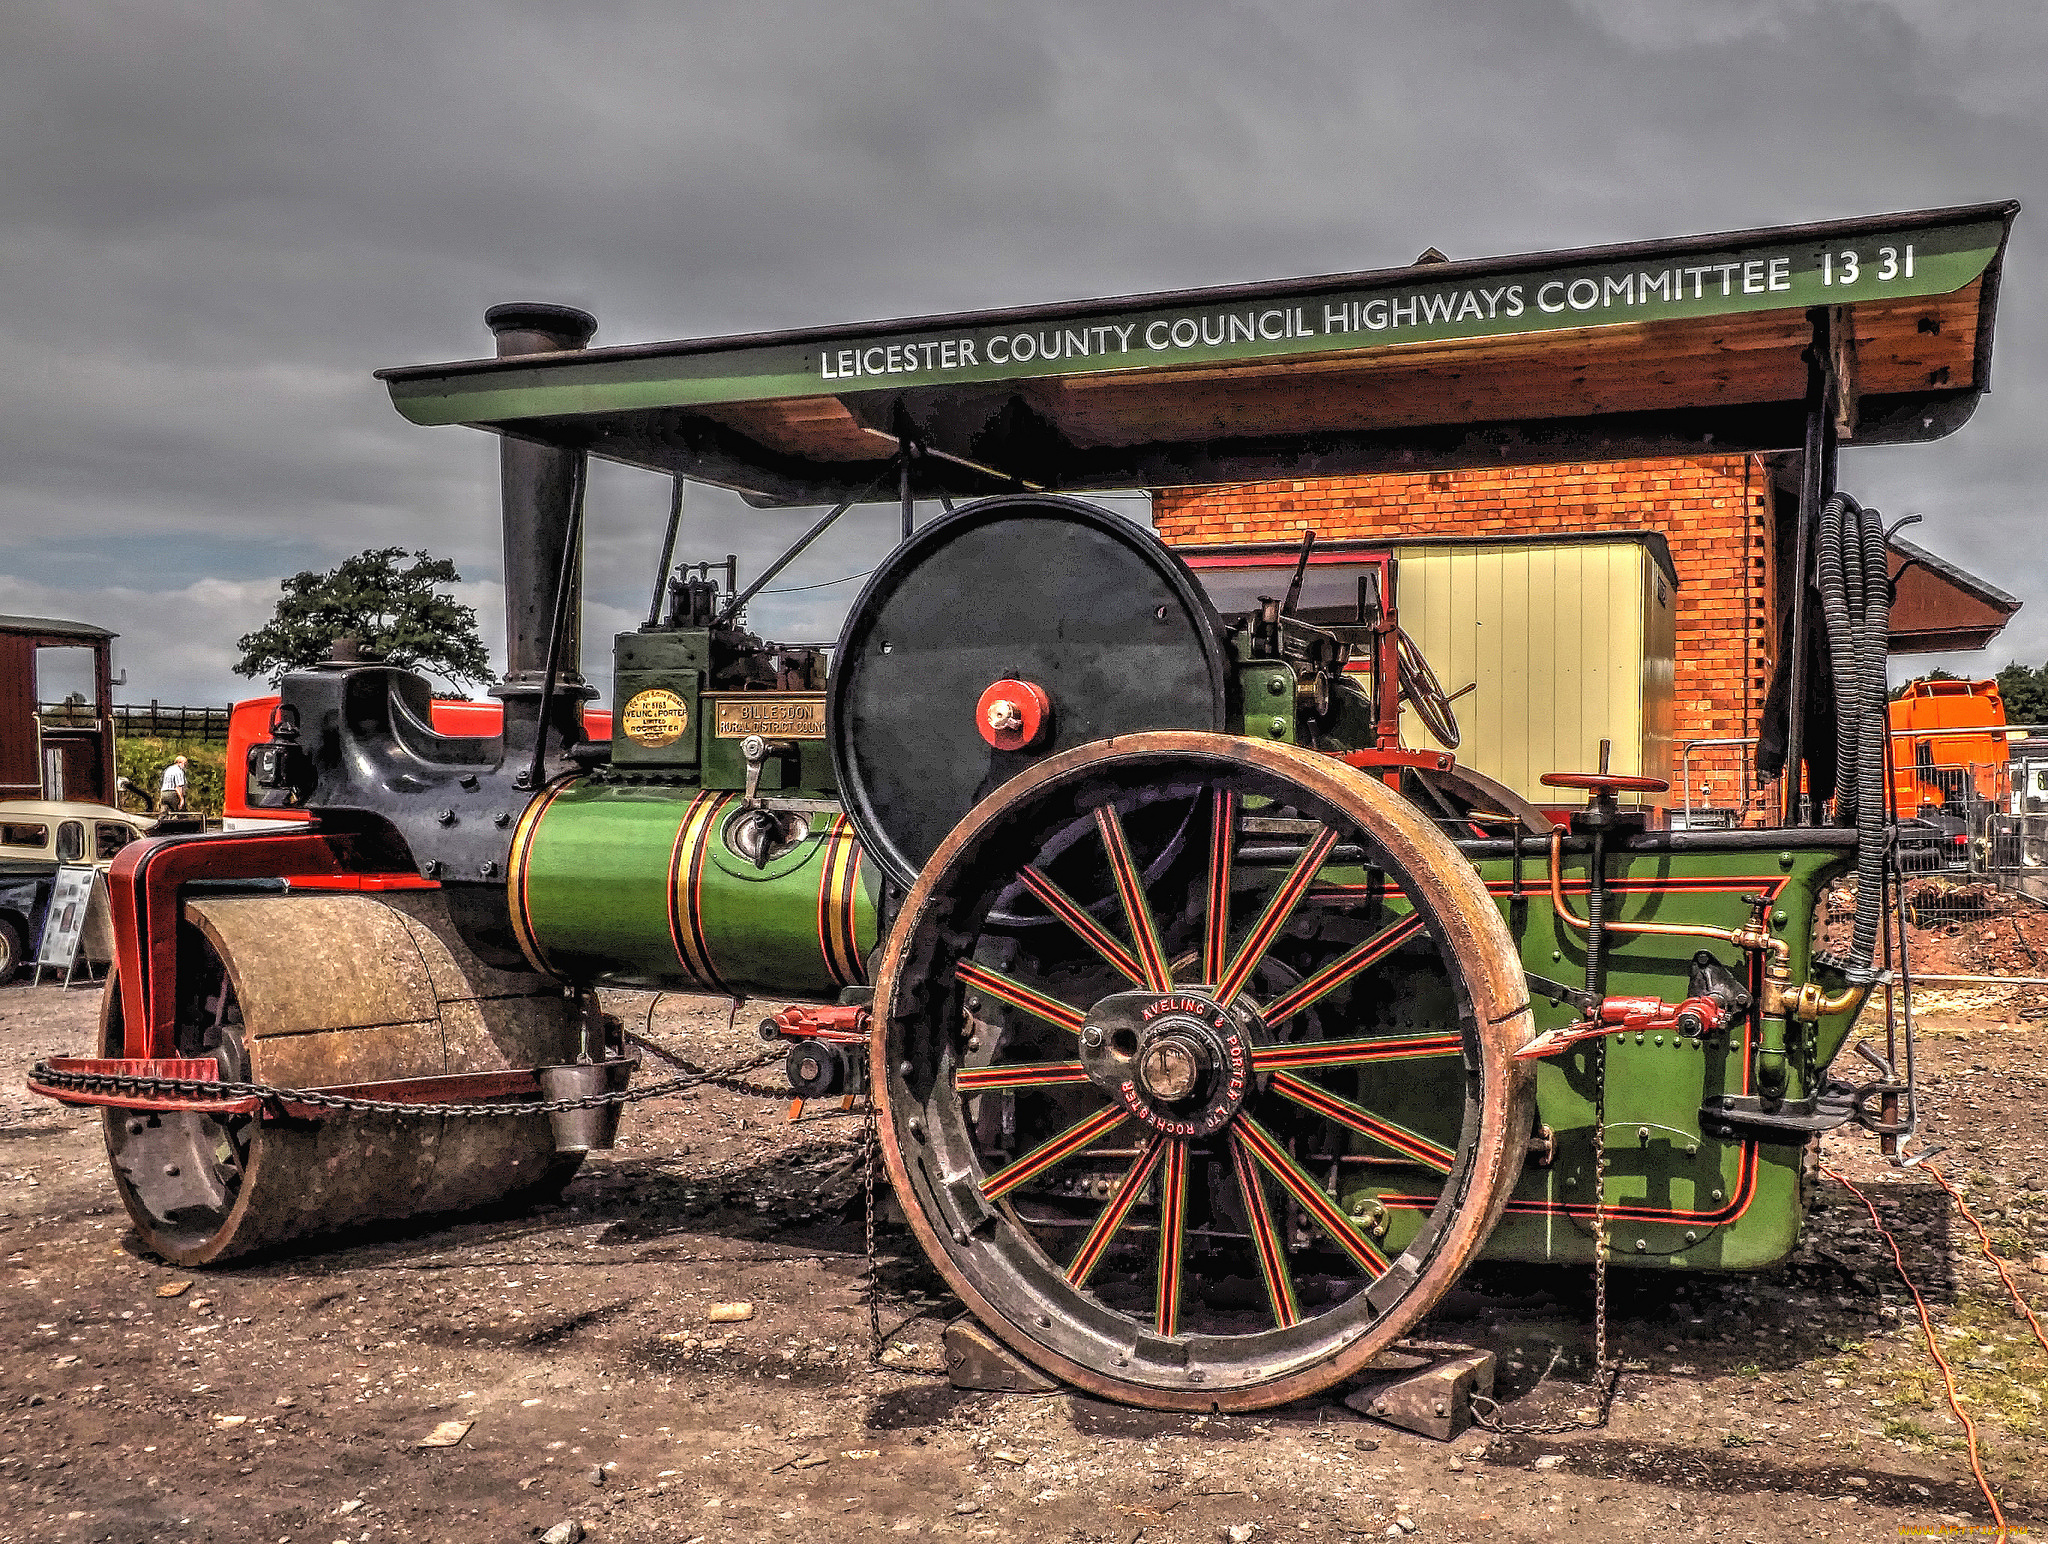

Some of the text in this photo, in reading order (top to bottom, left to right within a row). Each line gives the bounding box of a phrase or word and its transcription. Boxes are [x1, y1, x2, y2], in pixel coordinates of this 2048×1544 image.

[820, 244, 1915, 380] LEICESTER COUNTY COUNCIL HIGHWAYS COMMITTEE 13 31
[720, 721, 751, 733] RURAL
[753, 721, 794, 733] DISTRICT
[741, 705, 814, 720] BILLESDON
[1141, 998, 1205, 1021] AVELING
[1226, 1034, 1246, 1101] PORTER
[1121, 1079, 1195, 1135] ROCHESTER
